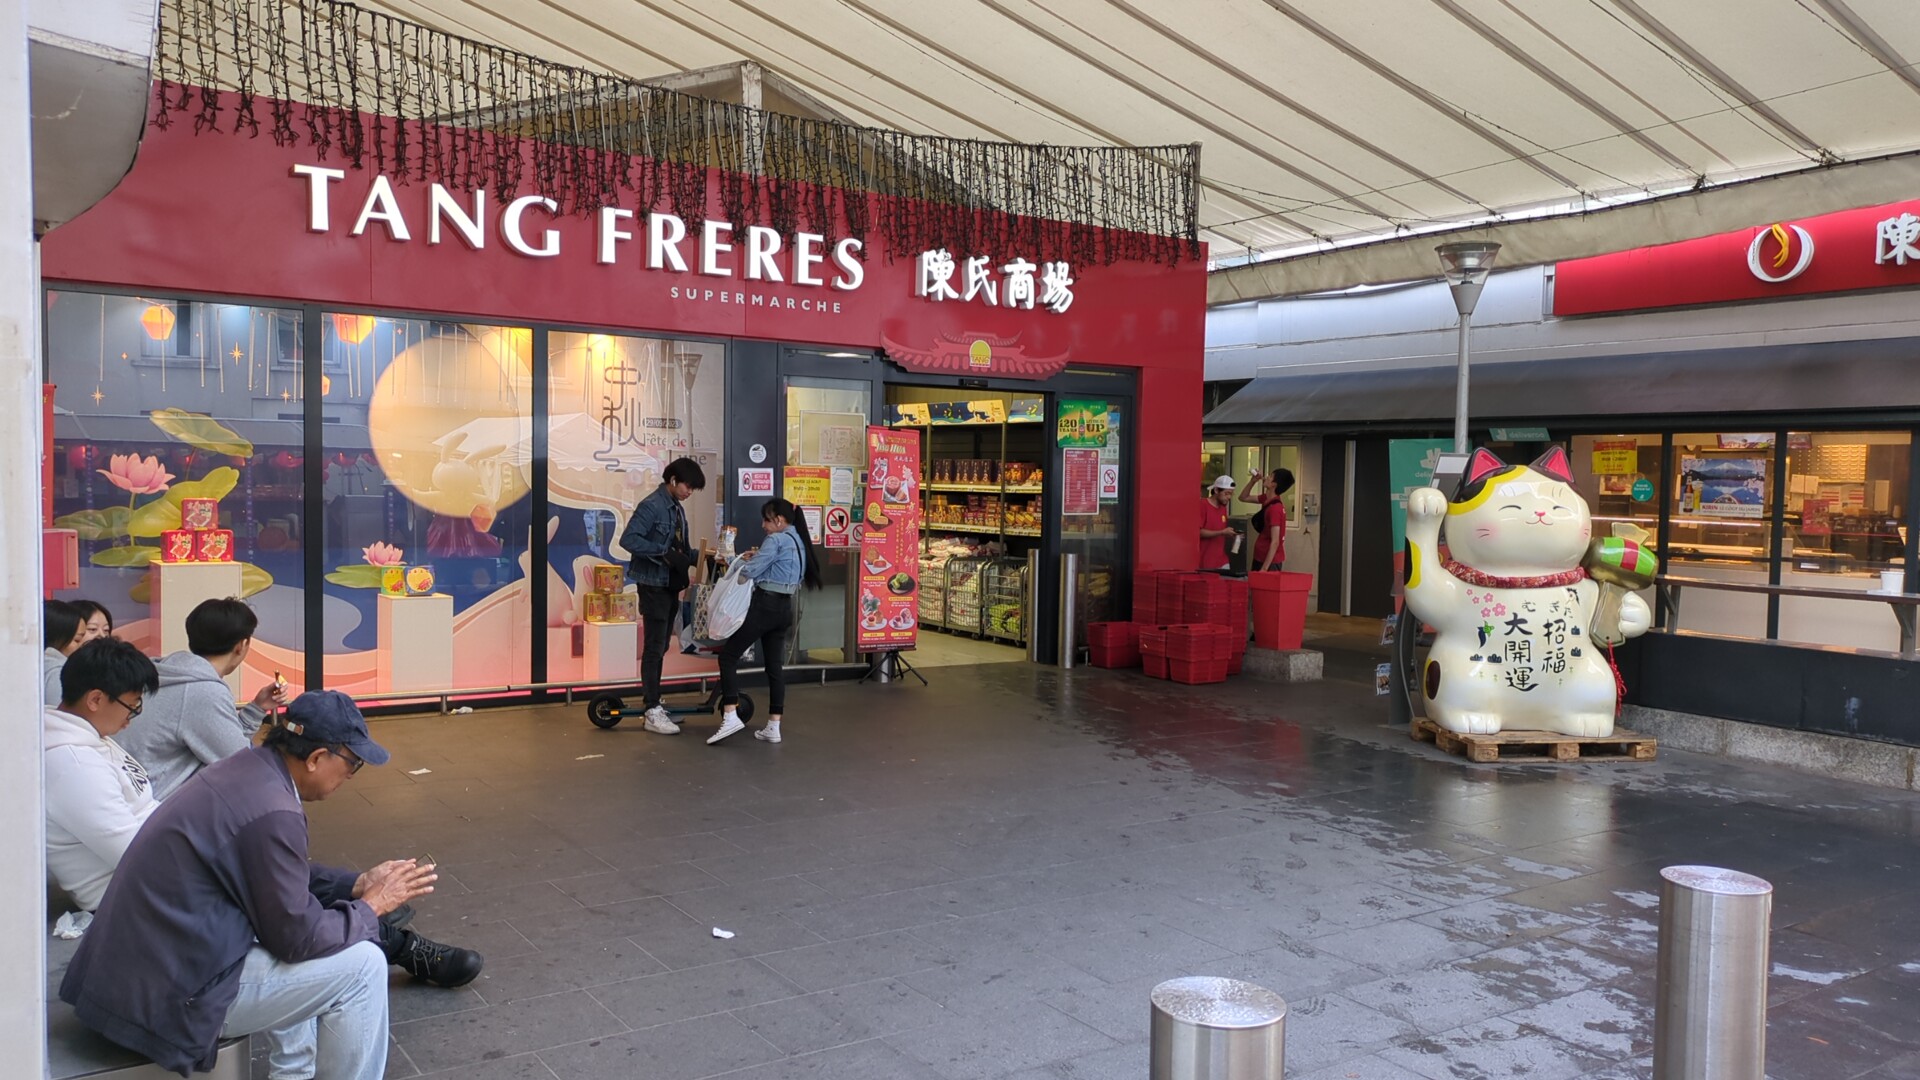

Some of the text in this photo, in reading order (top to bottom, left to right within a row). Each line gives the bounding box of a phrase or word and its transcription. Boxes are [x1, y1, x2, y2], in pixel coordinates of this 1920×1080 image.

[293, 163, 865, 291] TANG FRERES
[918, 247, 1074, 313] 陳氏商場
[670, 286, 841, 314] SUPERMARCHE
[970, 354, 990, 364] TANG
[643, 433, 701, 448] Fête de la
[1086, 424, 1105, 433] UP
[1508, 431, 1545, 439] deliveroo
[1504, 612, 1540, 692] 大開運
[1541, 618, 1567, 674] 招福
